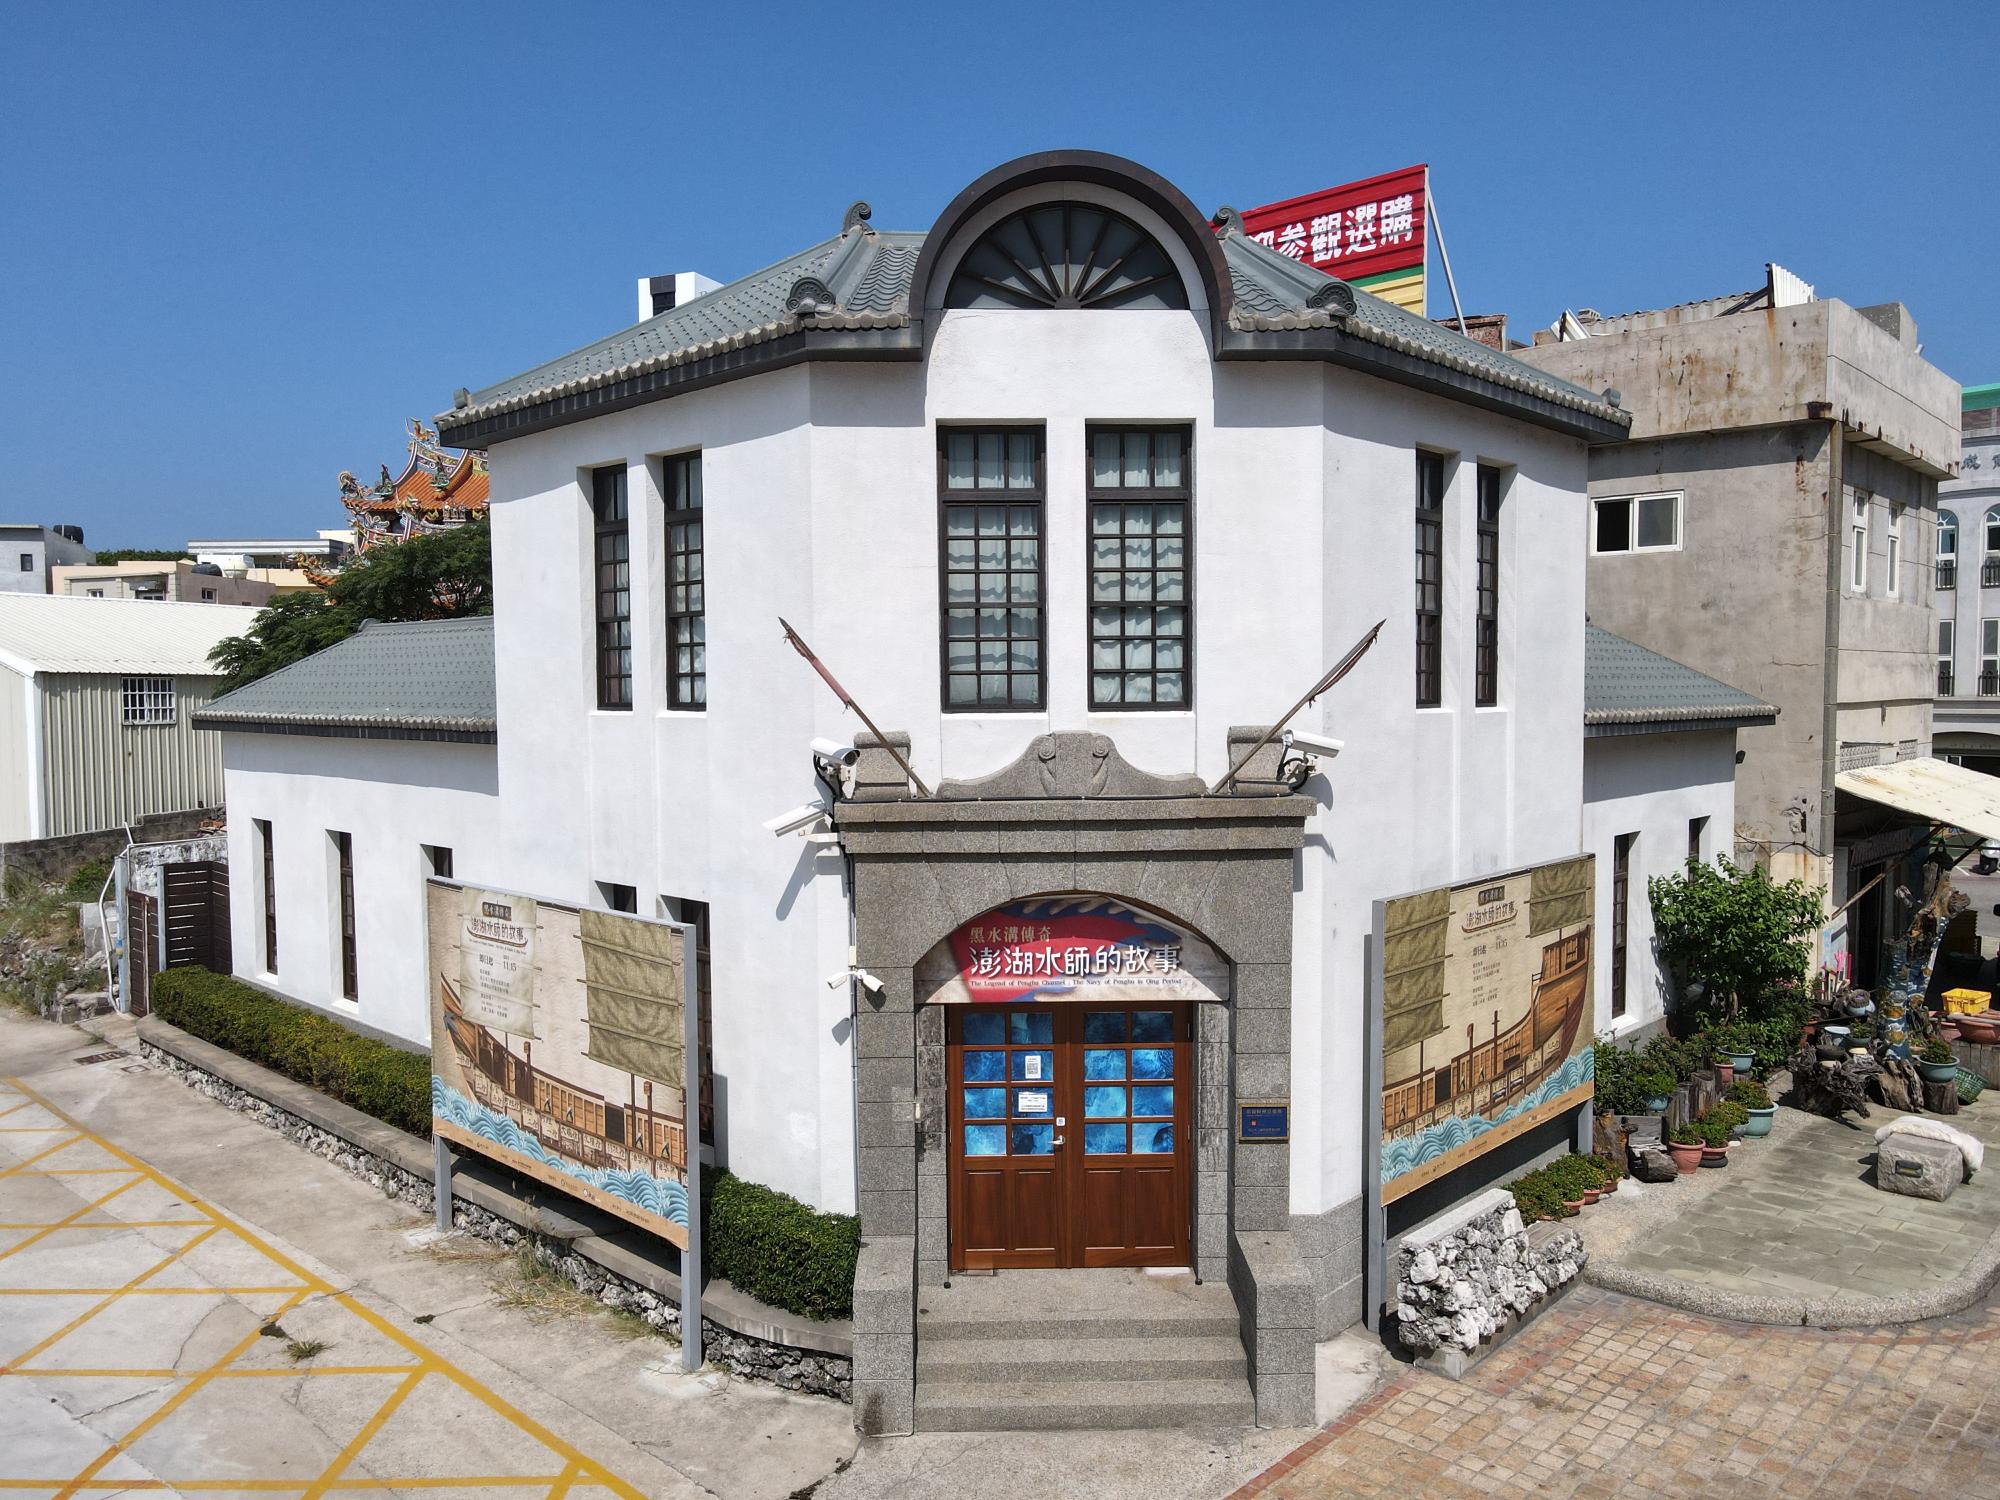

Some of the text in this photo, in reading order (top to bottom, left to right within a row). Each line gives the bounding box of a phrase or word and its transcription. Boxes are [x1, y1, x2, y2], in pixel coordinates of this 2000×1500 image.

[471, 915, 525, 943] 澎湖水師的故事
[969, 925, 1051, 943] 黑水溝傳奇
[969, 944, 1182, 978] 澎湖水師的故事
[1113, 978, 1135, 986] Penghu
[1146, 978, 1159, 986] Qing
